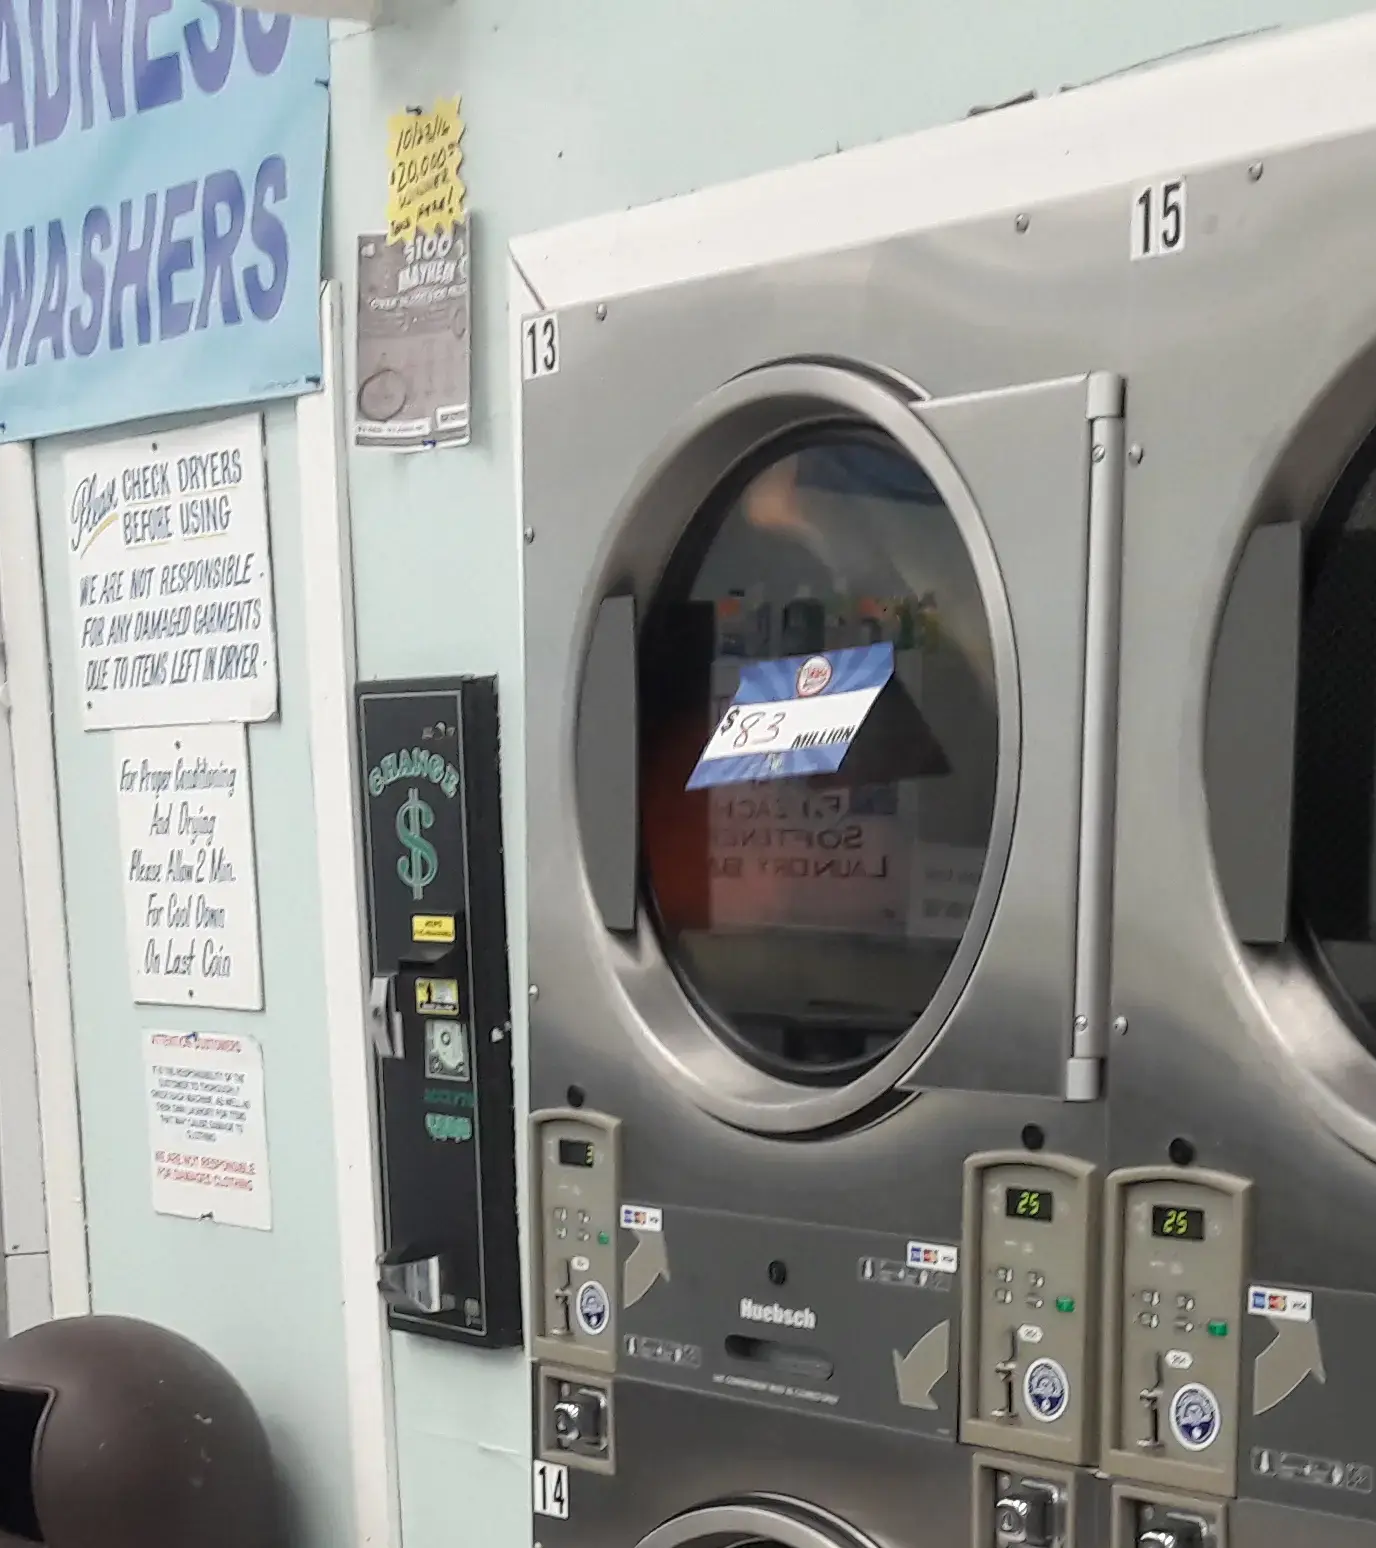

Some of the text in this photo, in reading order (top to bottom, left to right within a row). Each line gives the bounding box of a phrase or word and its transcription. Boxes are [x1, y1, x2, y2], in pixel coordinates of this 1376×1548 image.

[1137, 181, 1182, 254] 15
[526, 317, 557, 376] 13
[71, 448, 242, 552] Please CHECK DRYERS
[124, 495, 232, 545] BEFORE USING
[79, 552, 255, 607] WE ARE NOT RESPONSIBLE
[106, 612, 132, 646] ANY
[133, 605, 193, 643] DAMAGED
[193, 597, 262, 636] GARMENTS
[84, 656, 111, 691] DUE
[112, 656, 129, 690] TO
[128, 650, 169, 689] ITEMS
[169, 647, 203, 685] LEFT
[216, 642, 261, 681] DRYER
[789, 724, 856, 750] MILLION
[119, 758, 136, 793] For
[368, 746, 460, 799] CHANGE
[149, 799, 217, 846] And Drying
[128, 848, 162, 883] Please
[165, 848, 194, 883] Allow
[194, 848, 207, 883] 2
[146, 892, 226, 929] For Cool Down
[143, 937, 232, 978] On Last Coin
[1016, 1191, 1041, 1216] 25
[1162, 1210, 1189, 1235] 25
[738, 1297, 817, 1330] Huebsch
[538, 1465, 565, 1515] 14
